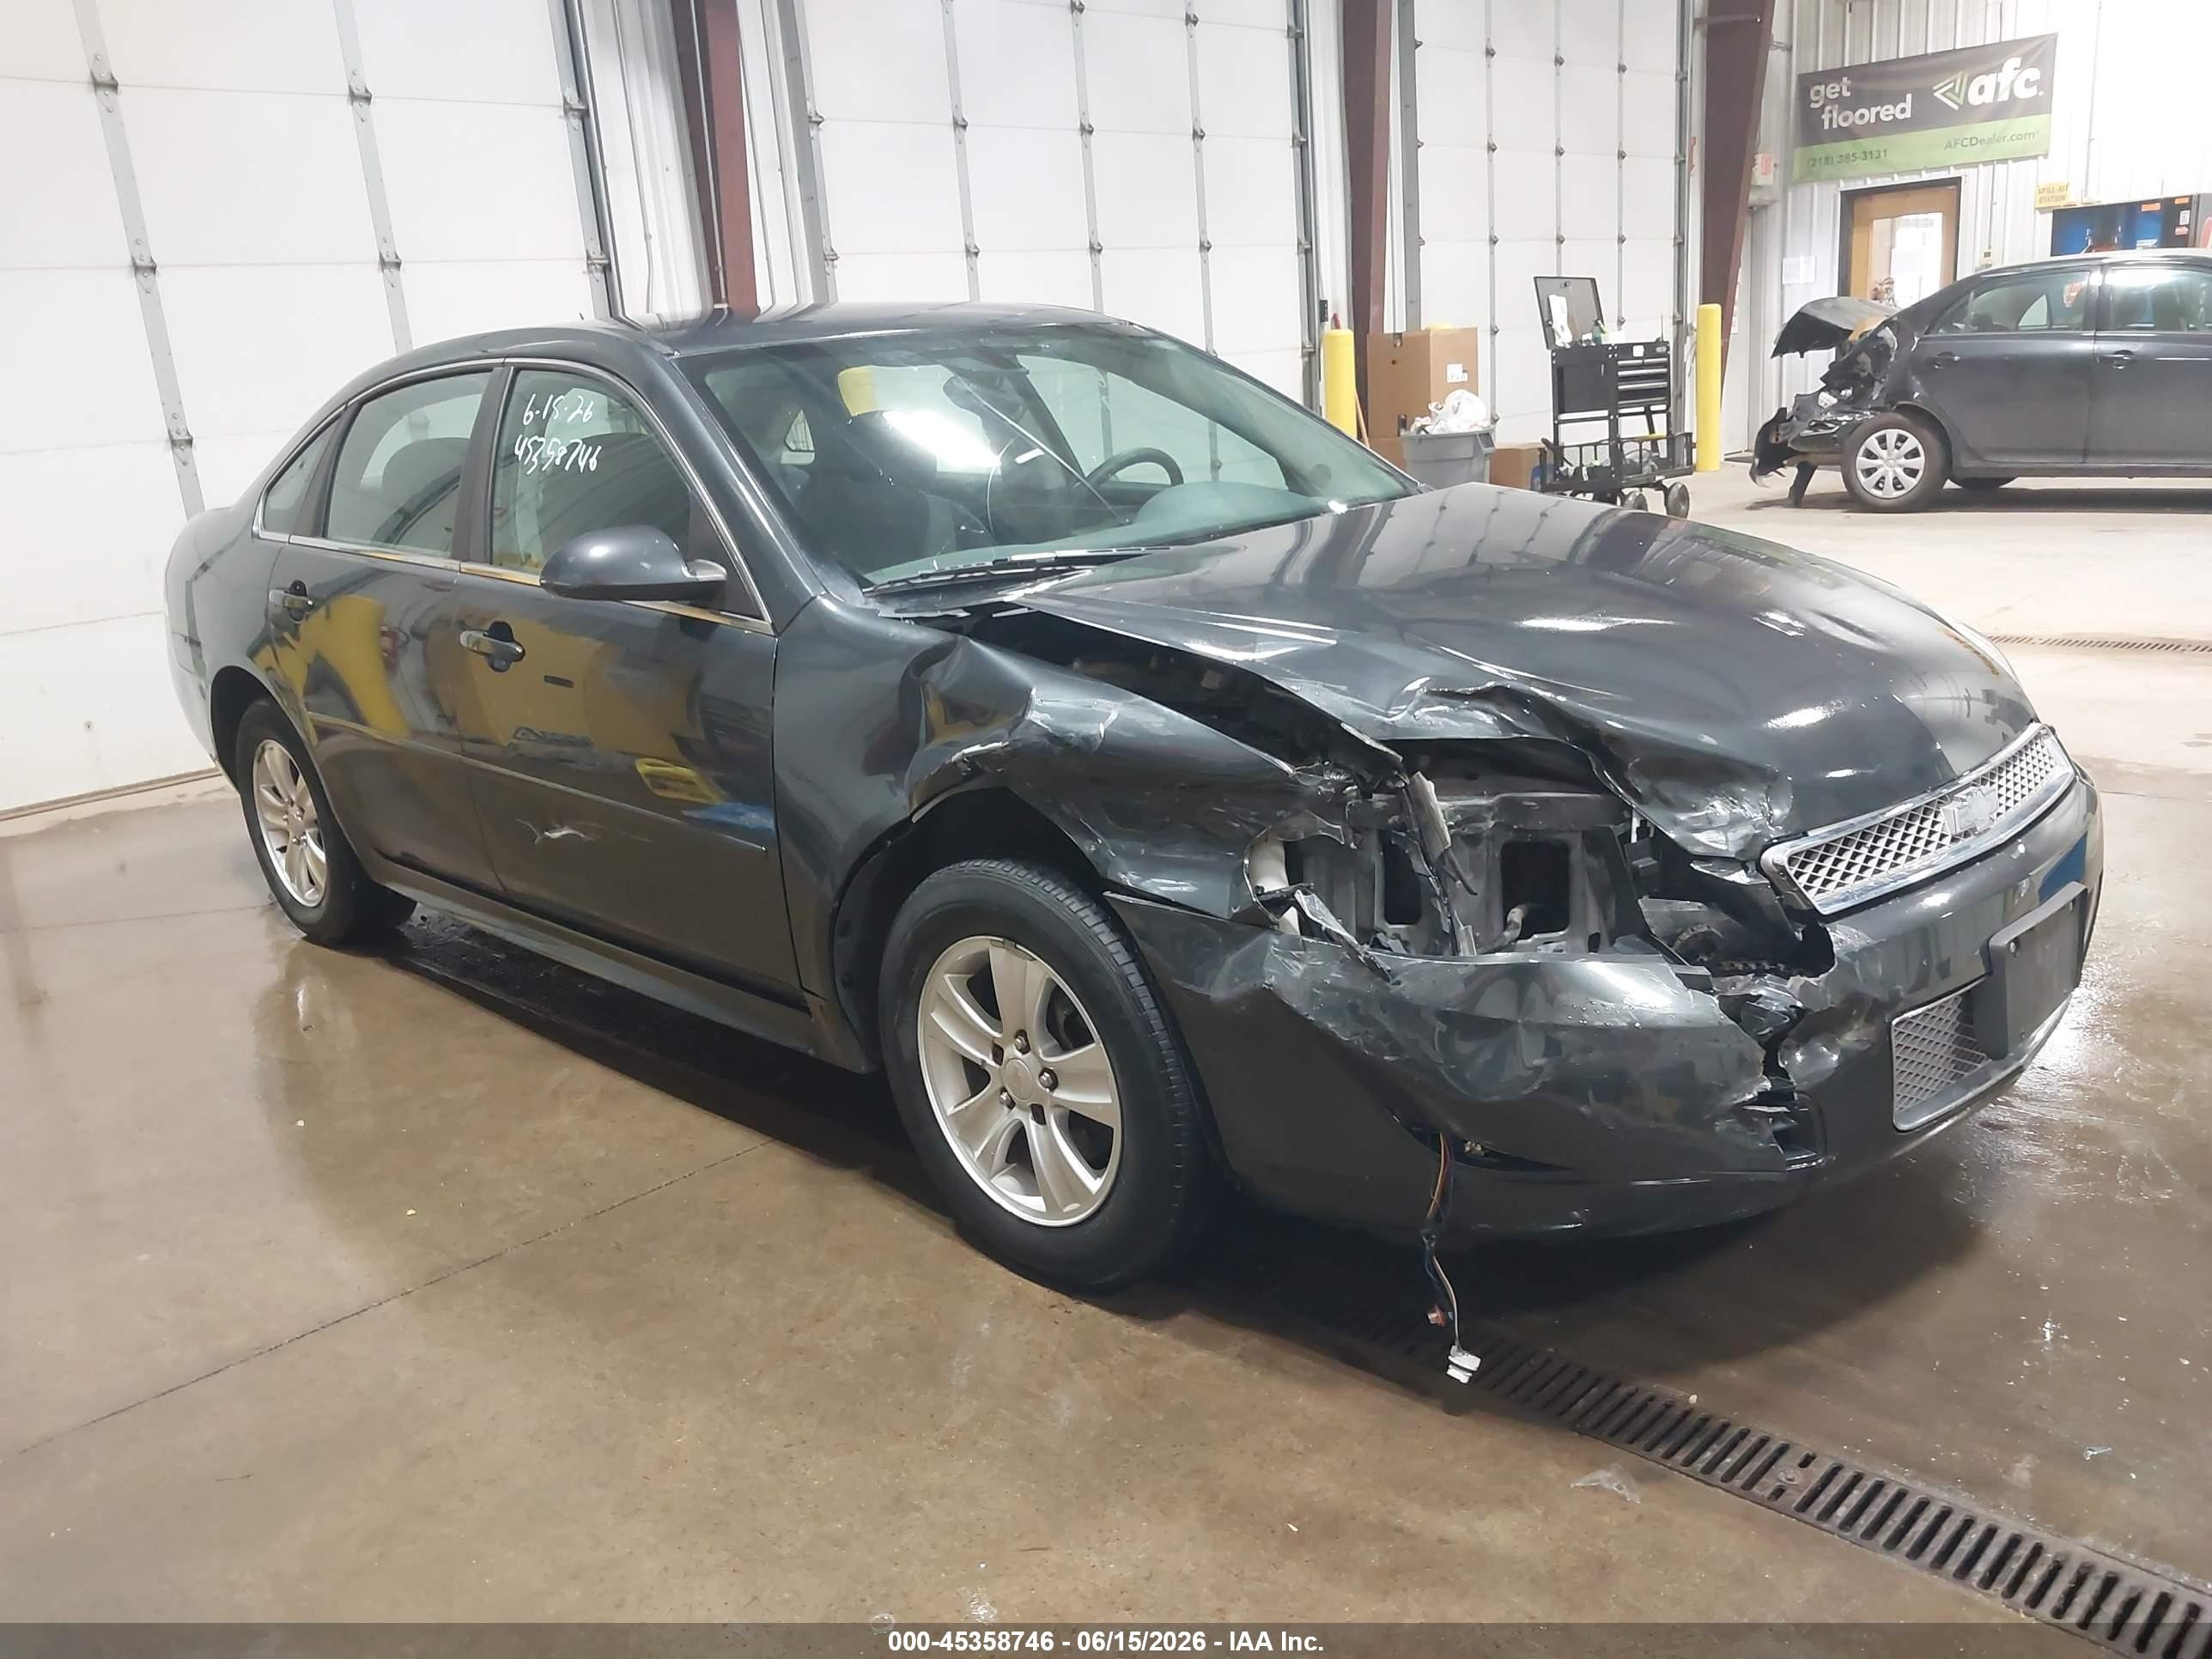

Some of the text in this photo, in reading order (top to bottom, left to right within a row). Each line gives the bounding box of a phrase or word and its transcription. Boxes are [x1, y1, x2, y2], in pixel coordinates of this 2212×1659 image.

[1809, 76, 1851, 108] get
[1821, 94, 1912, 130] floored
[1807, 155, 1834, 168] (218)
